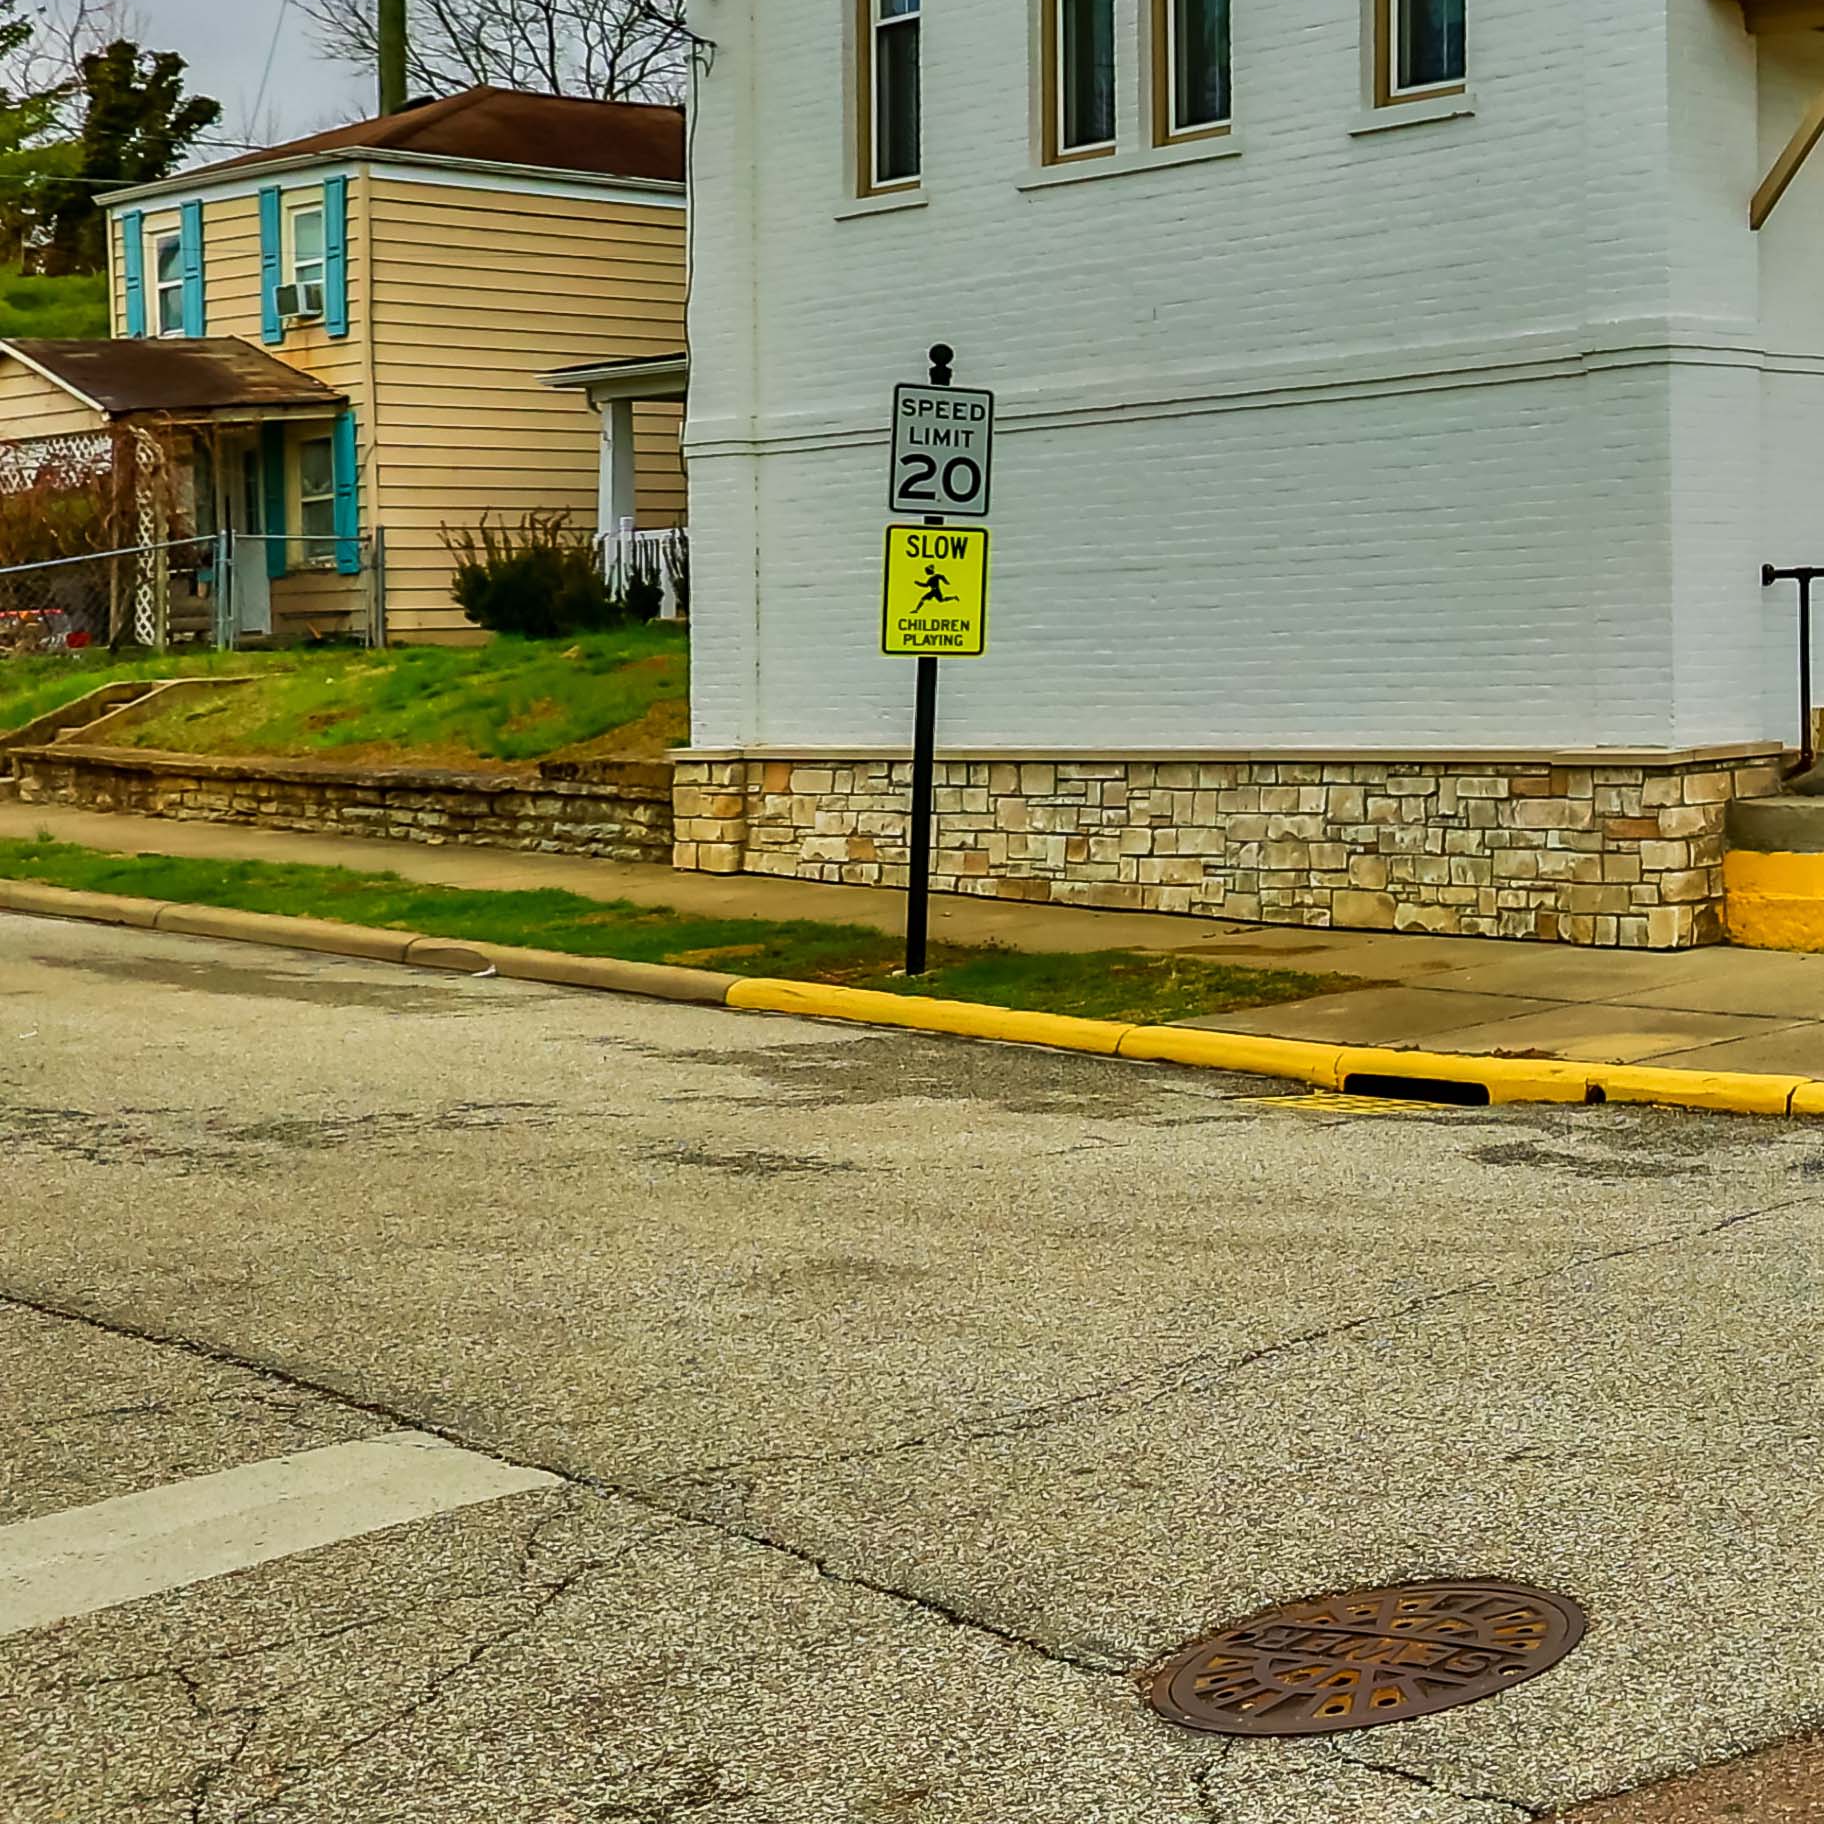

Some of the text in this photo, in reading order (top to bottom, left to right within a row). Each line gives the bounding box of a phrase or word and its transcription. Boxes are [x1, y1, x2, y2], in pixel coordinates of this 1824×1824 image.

[901, 398, 986, 422] SPEED
[909, 426, 975, 448] LIMIT
[897, 453, 982, 502] 20
[906, 534, 968, 560] SLOW
[898, 618, 970, 632] CHILDREN
[903, 633, 964, 647] PLAYING
[1252, 1628, 1503, 1675] SEWER
